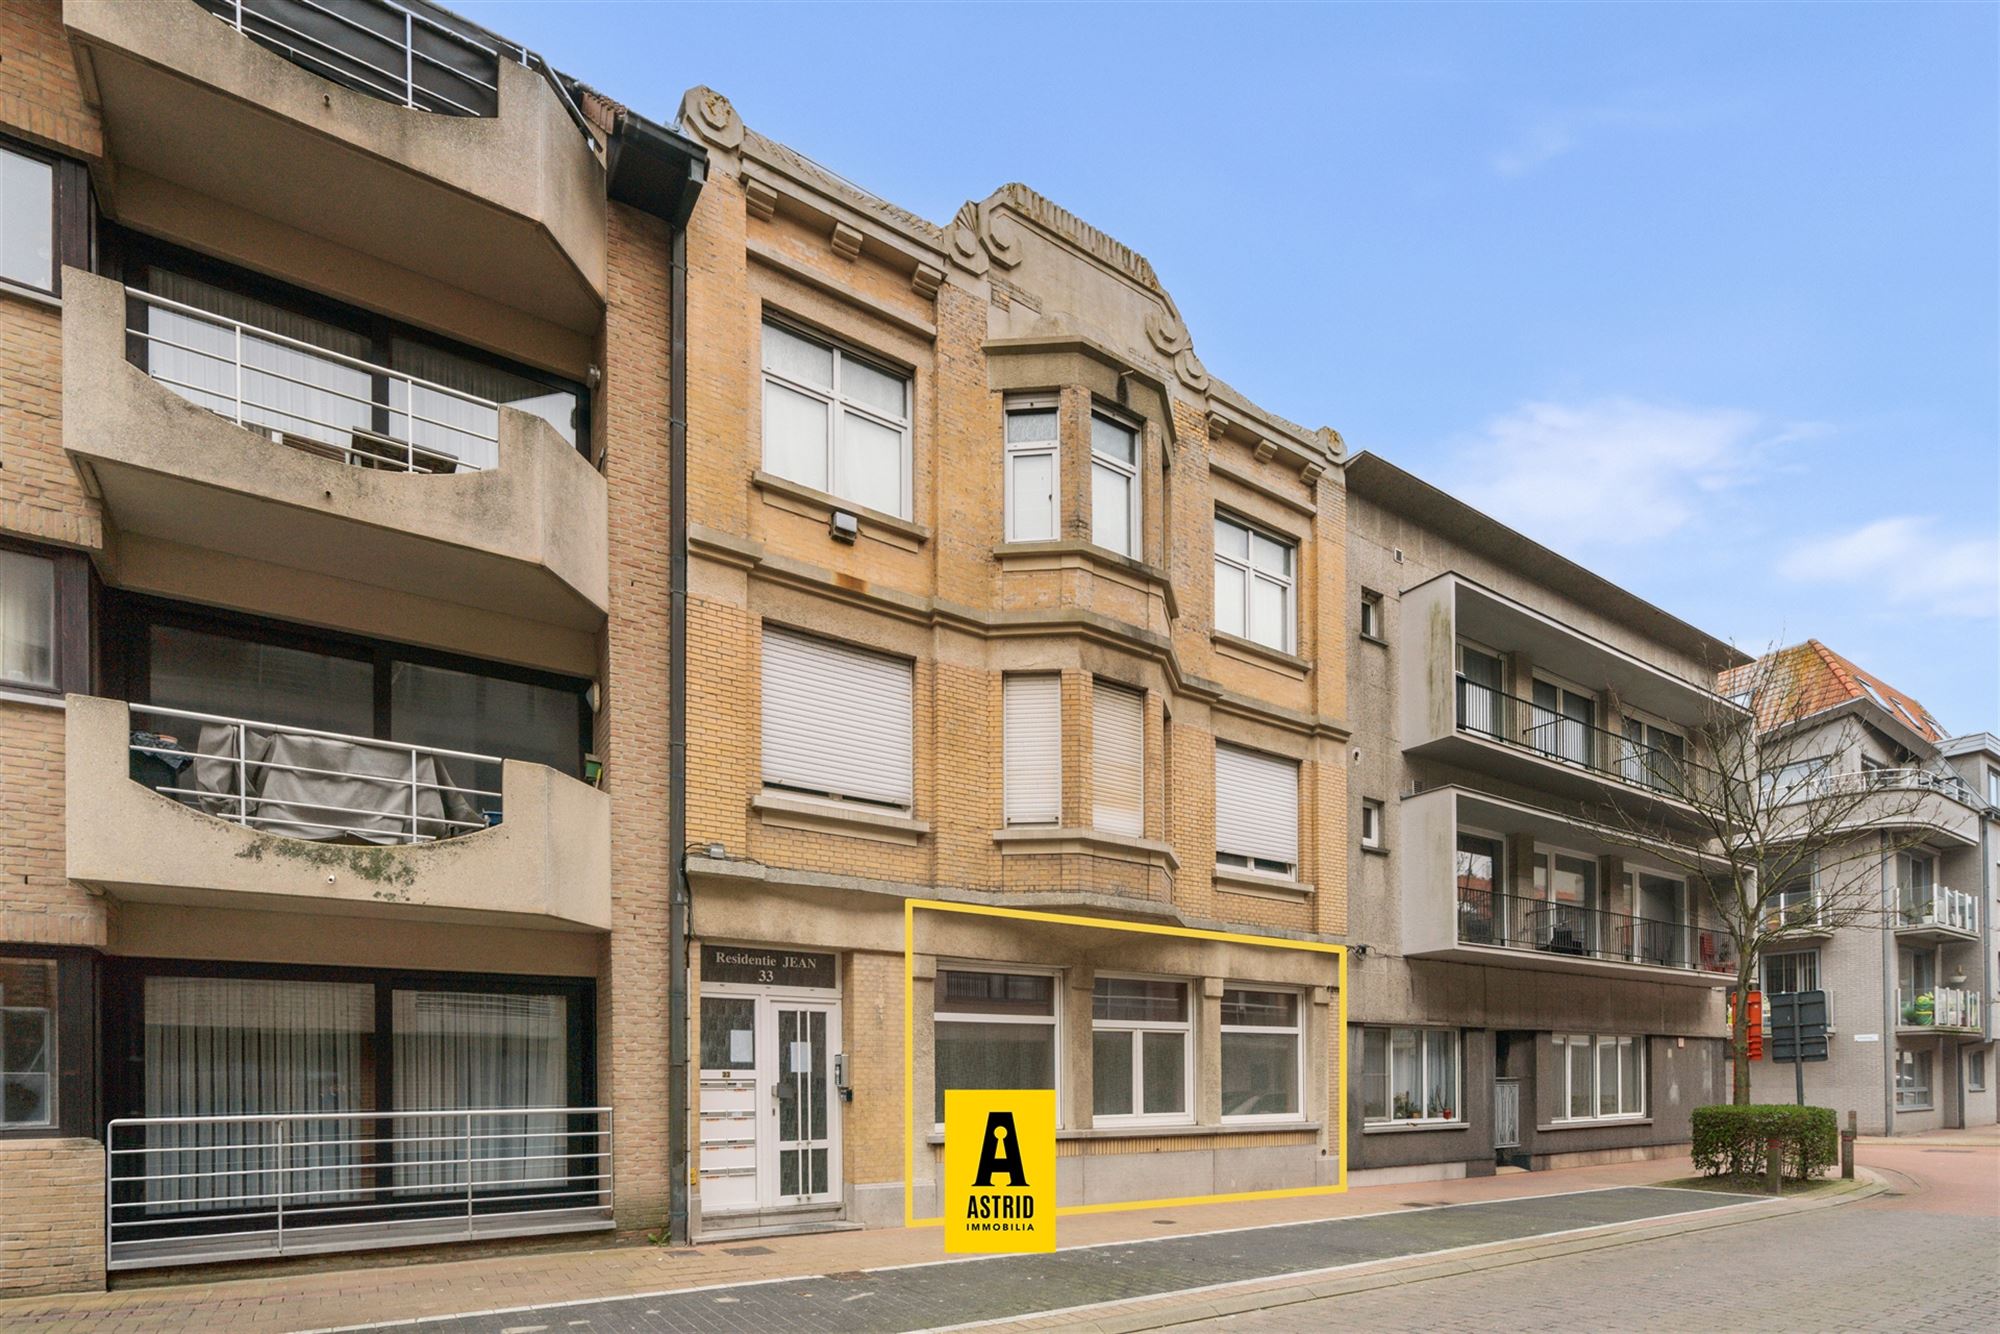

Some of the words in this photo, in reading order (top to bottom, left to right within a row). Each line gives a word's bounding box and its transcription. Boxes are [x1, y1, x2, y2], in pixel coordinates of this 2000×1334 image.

[716, 952, 777, 966] Residentie
[782, 956, 817, 969] JEAN
[758, 970, 774, 982] 33
